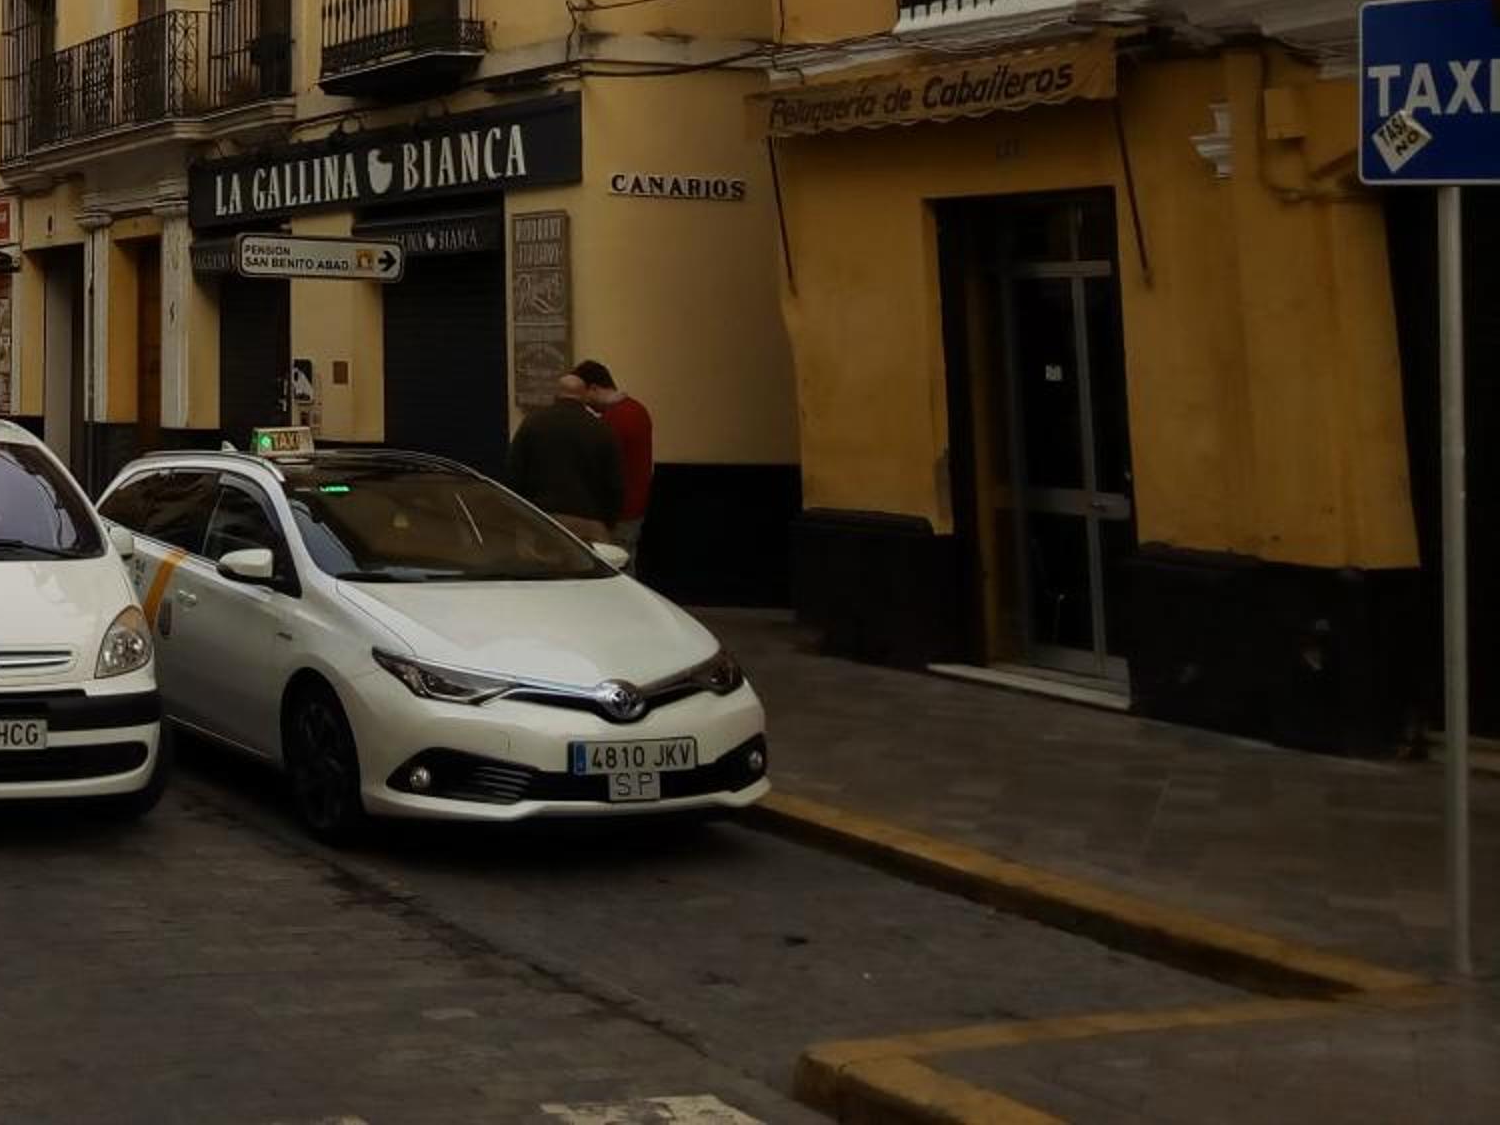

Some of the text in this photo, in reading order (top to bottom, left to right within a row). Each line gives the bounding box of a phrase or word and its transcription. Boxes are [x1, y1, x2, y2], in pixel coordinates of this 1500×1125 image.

[883, 83, 913, 114] de
[922, 63, 1074, 110] Caballeros
[1367, 58, 1500, 118] TAXI
[214, 124, 528, 217] LA GALLINA BIANCA
[611, 174, 745, 199] CANARIOS
[243, 255, 269, 268] SAN
[271, 257, 314, 270] BENITO
[317, 259, 350, 271] ABAD
[591, 743, 691, 769] 4810 JKV
[615, 772, 653, 797] SP
